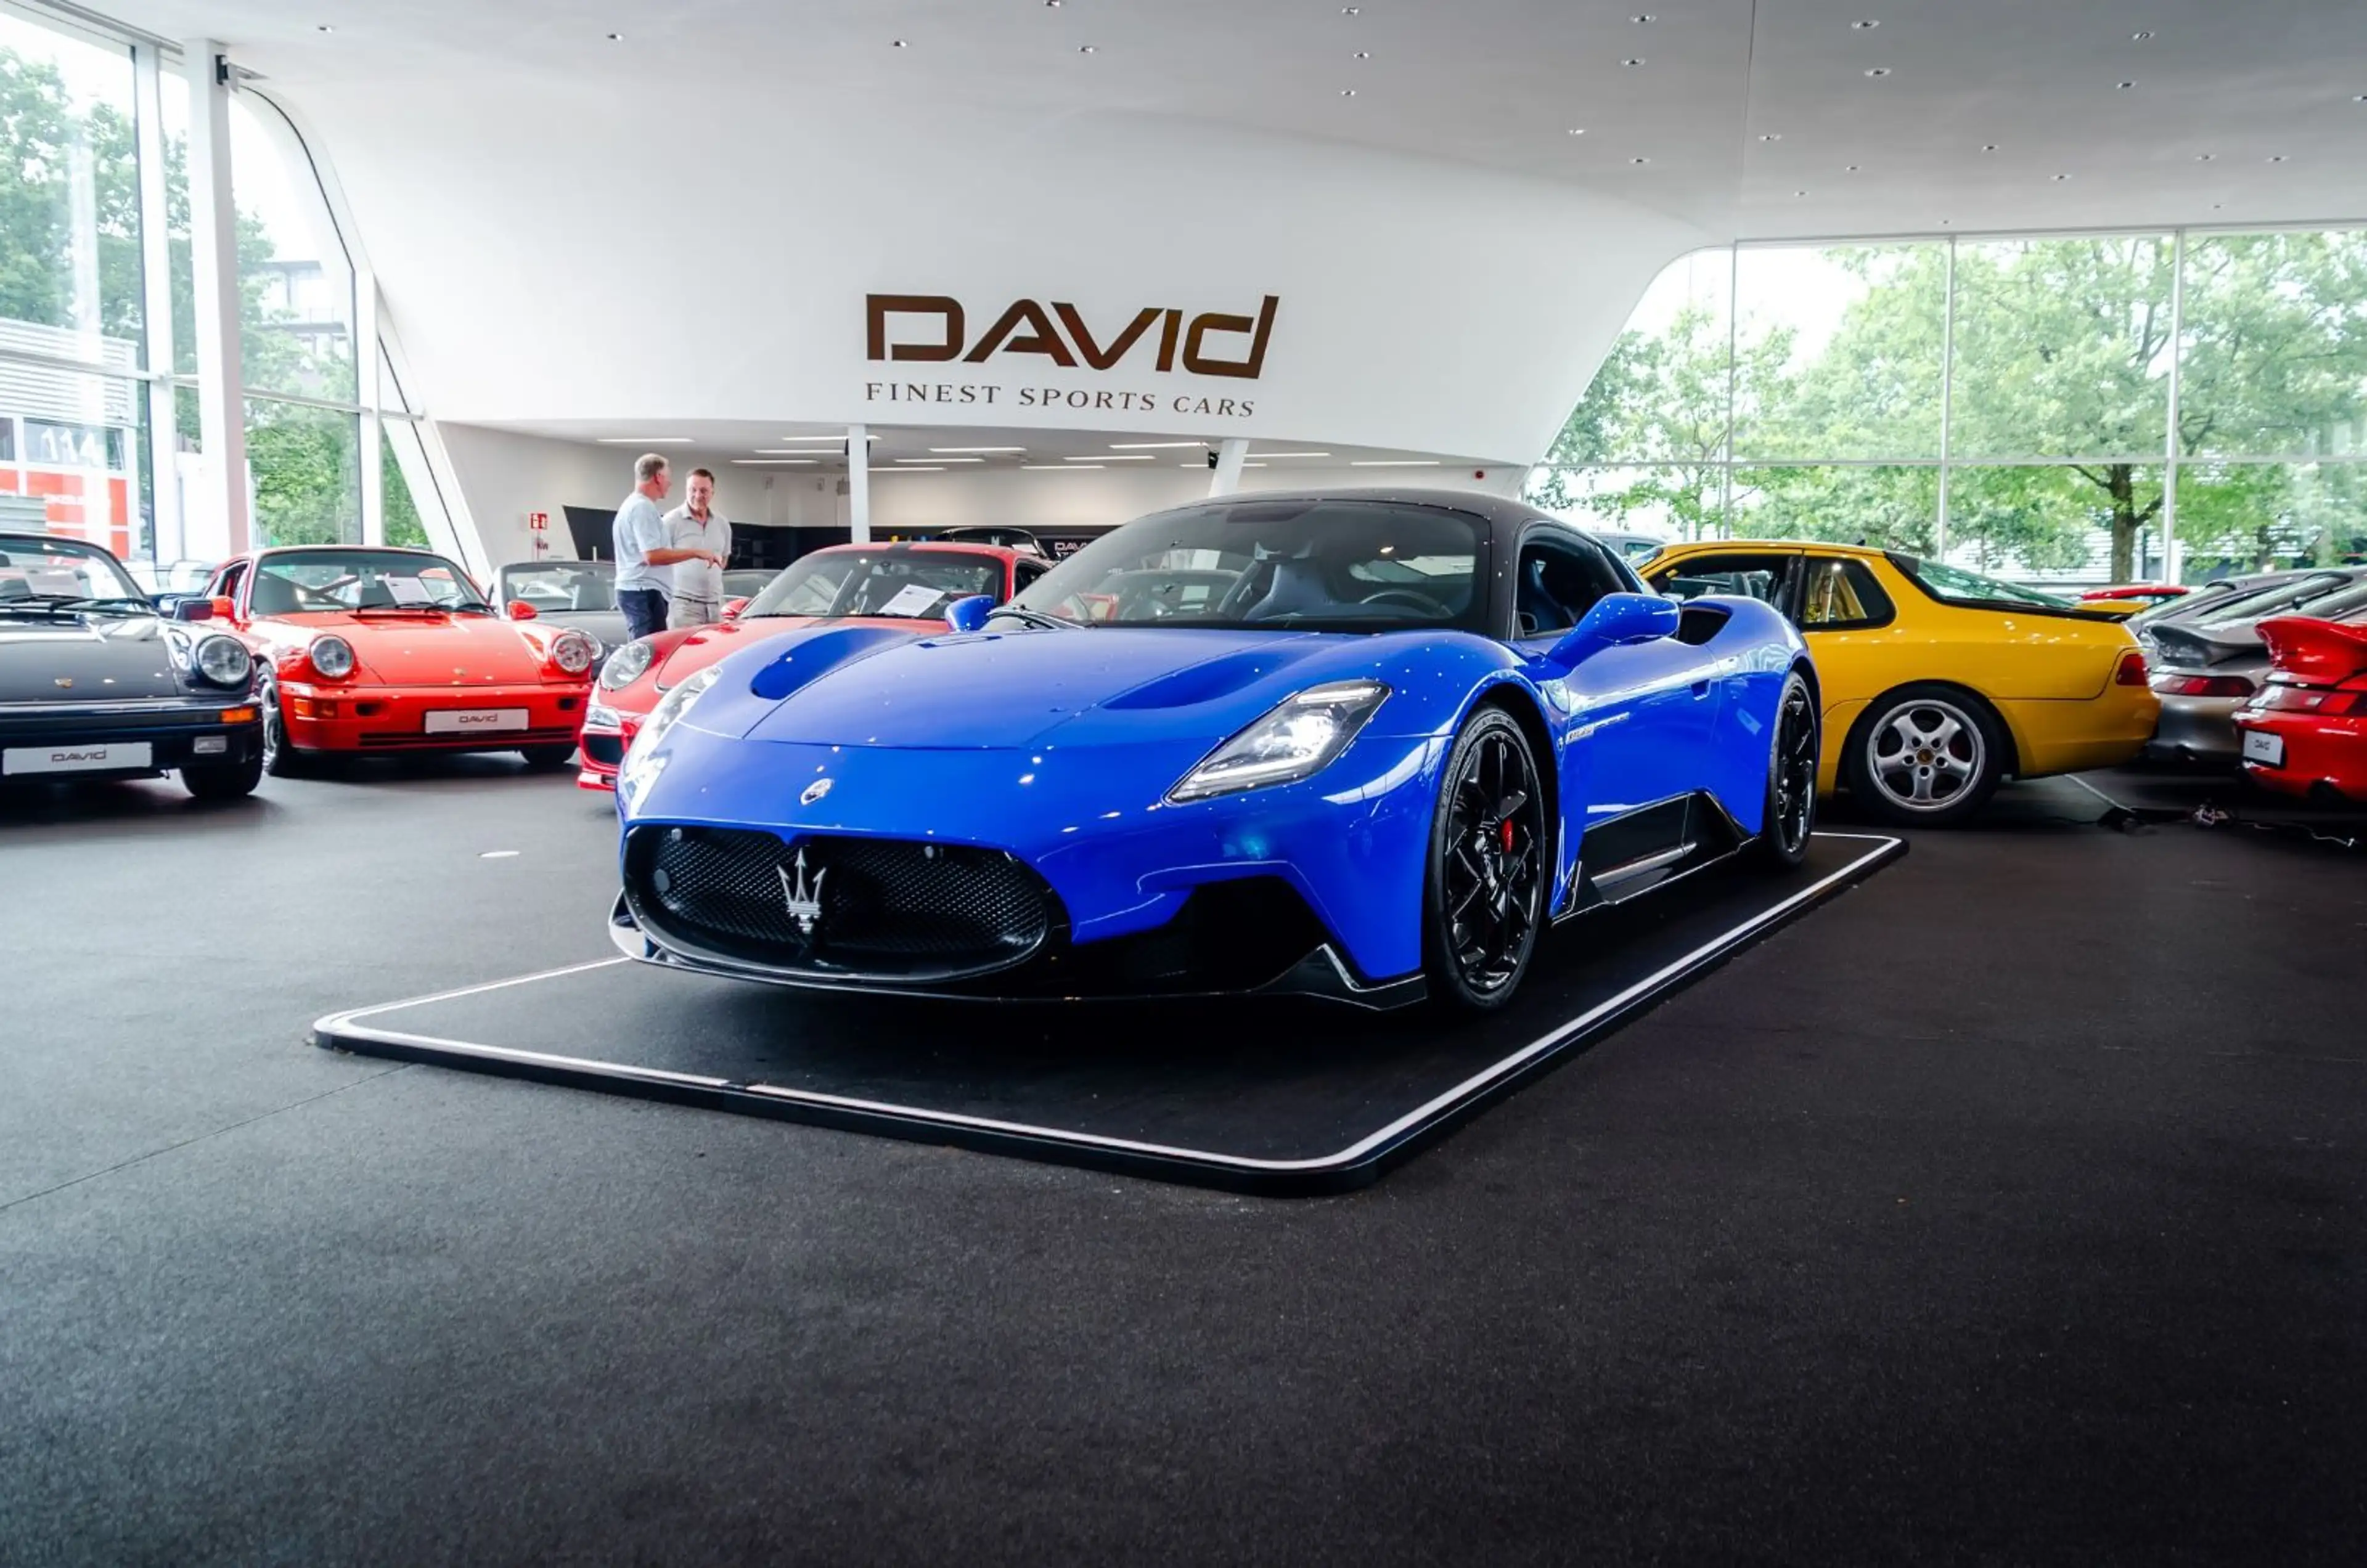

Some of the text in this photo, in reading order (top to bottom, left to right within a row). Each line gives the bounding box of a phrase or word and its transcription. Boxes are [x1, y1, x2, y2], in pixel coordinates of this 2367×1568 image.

[865, 382, 1255, 417] FINEST SPORTS CARS
